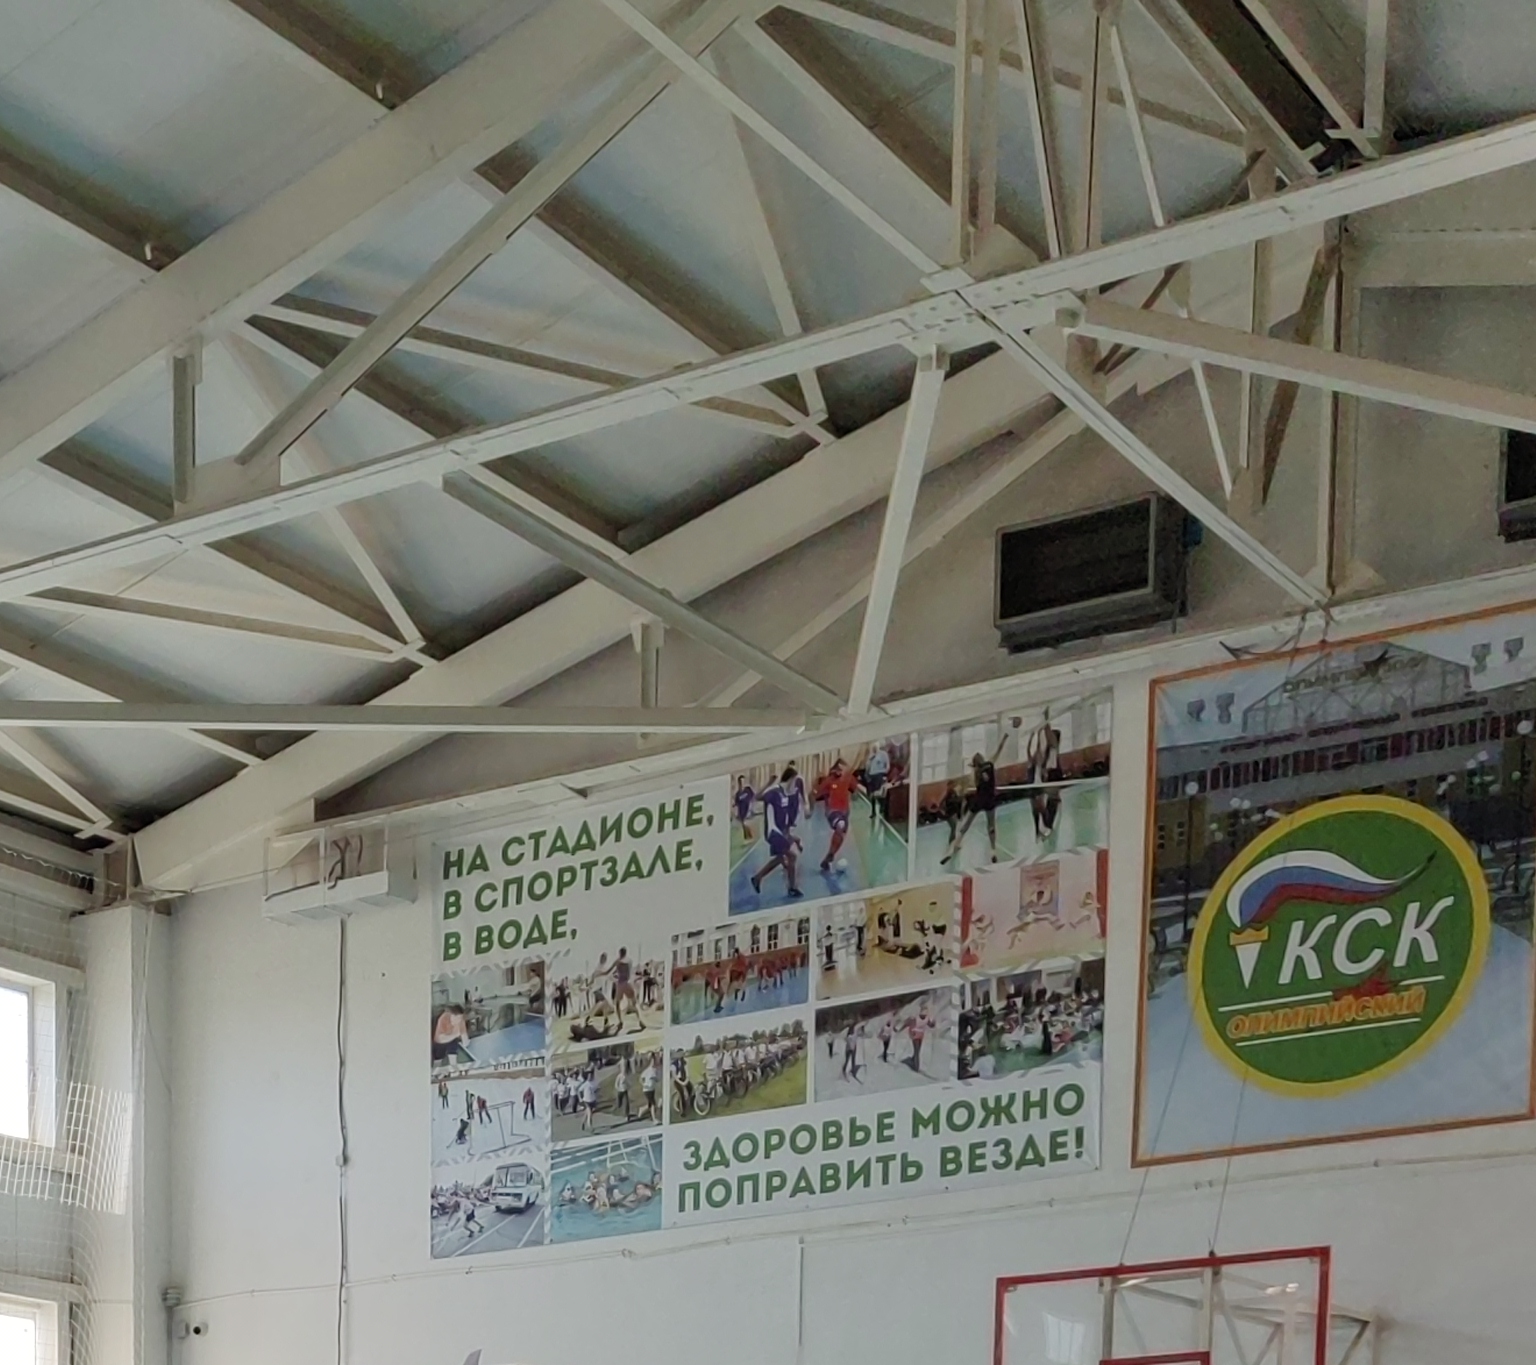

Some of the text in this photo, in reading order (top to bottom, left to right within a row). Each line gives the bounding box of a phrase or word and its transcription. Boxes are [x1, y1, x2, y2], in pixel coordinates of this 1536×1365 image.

[443, 793, 715, 881] НА СТАДИОНЕ,
[443, 838, 704, 921] В СПОРТЗАЛЕ,
[443, 908, 579, 962] В ВОДЕ,
[1277, 895, 1455, 985] КСК
[1226, 984, 1427, 1040] ОЛИМПИЙСКИЙ
[678, 1126, 1086, 1213] ПОПРАВИТЬ ВЕЗДЕ!
[682, 1083, 1086, 1171] ЗДОРОВЬЕ МОЖНО
